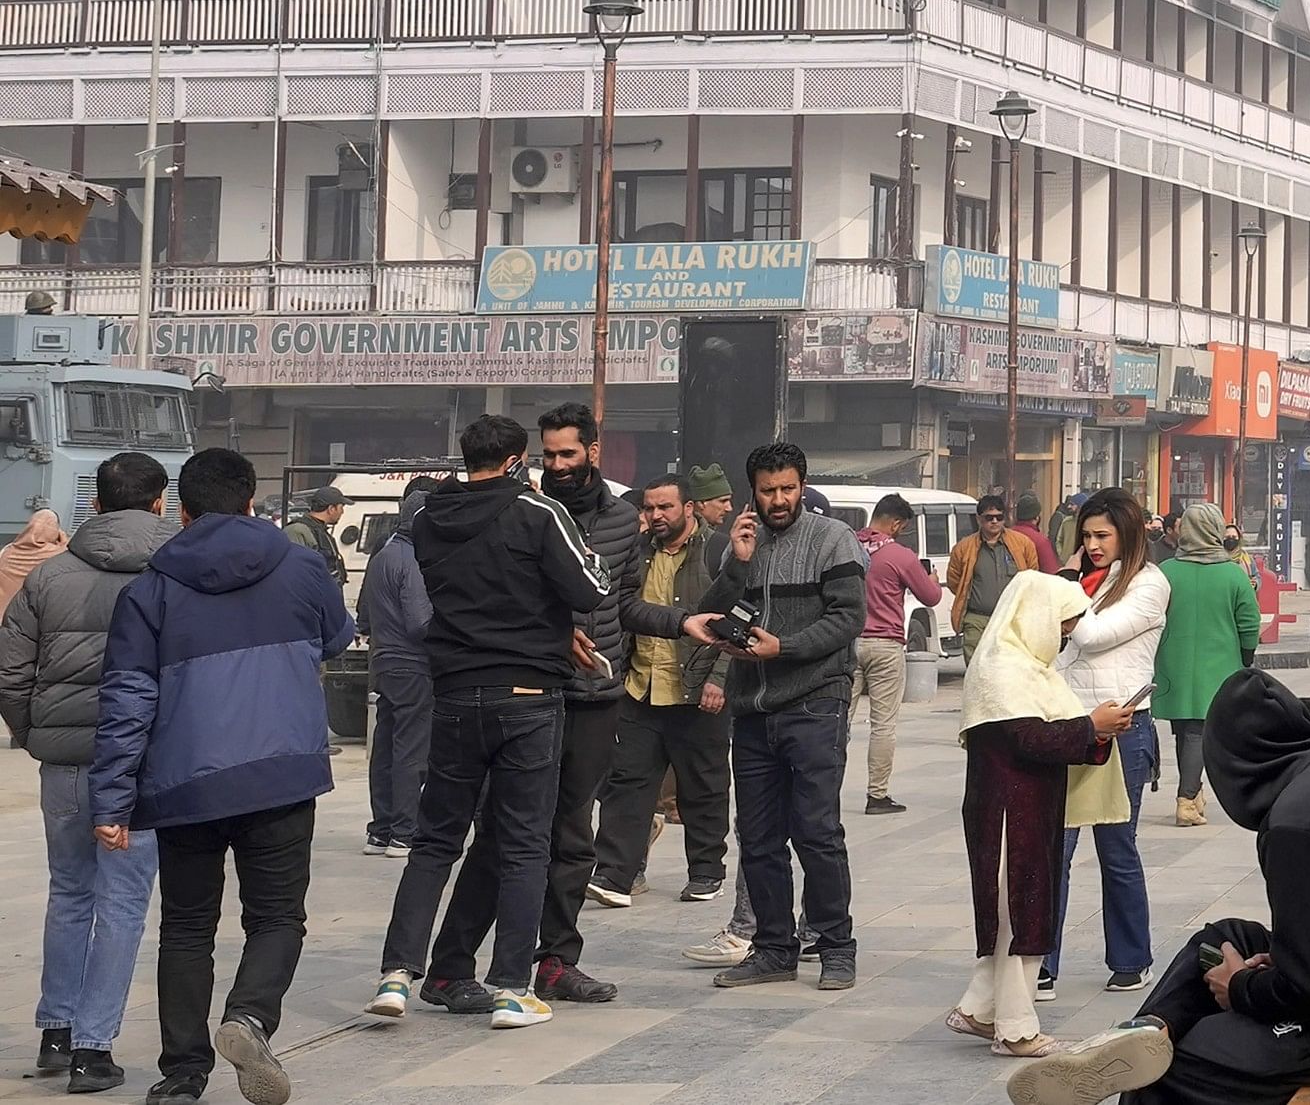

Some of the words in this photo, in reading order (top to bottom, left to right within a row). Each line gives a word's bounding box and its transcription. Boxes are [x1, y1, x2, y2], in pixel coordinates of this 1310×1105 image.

[543, 249, 625, 271] HOTL
[635, 246, 706, 271] LALA
[716, 245, 802, 270] RUKH
[652, 271, 690, 281] AND
[964, 254, 996, 281] HOTEL
[999, 259, 1025, 285] LAA
[1028, 263, 1058, 289] RUKH
[480, 302, 487, 311] A
[492, 302, 512, 311] UNIT
[517, 302, 529, 311] OF
[533, 301, 565, 310] JAMMU
[571, 301, 578, 310] &
[631, 300, 669, 309] TOURISM
[674, 298, 733, 309] DEVELOPMENT
[738, 297, 800, 308] CORPORATION
[983, 292, 1040, 314] RESTARANT
[270, 319, 490, 355] GOVERNMENT
[499, 318, 579, 353] ARTS
[237, 359, 266, 369] Saga
[269, 358, 281, 367] of
[284, 358, 332, 368] Genuine
[337, 358, 344, 367] &
[347, 358, 400, 368] Exquisite
[404, 357, 467, 366] Traditional
[469, 357, 514, 367] Jammu
[517, 357, 523, 366] &
[527, 356, 575, 366] Kashmir
[580, 355, 649, 365] Hadicrafts
[985, 352, 1008, 370] ARTS
[290, 370, 313, 379] unit
[317, 369, 328, 379] of
[331, 369, 352, 379] J&K
[356, 369, 424, 379] Handicrafts
[427, 368, 462, 379] (Sales
[465, 368, 472, 378] &
[475, 368, 518, 379] Export)
[521, 367, 592, 378] Corporation
[1280, 391, 1291, 405] DRY
